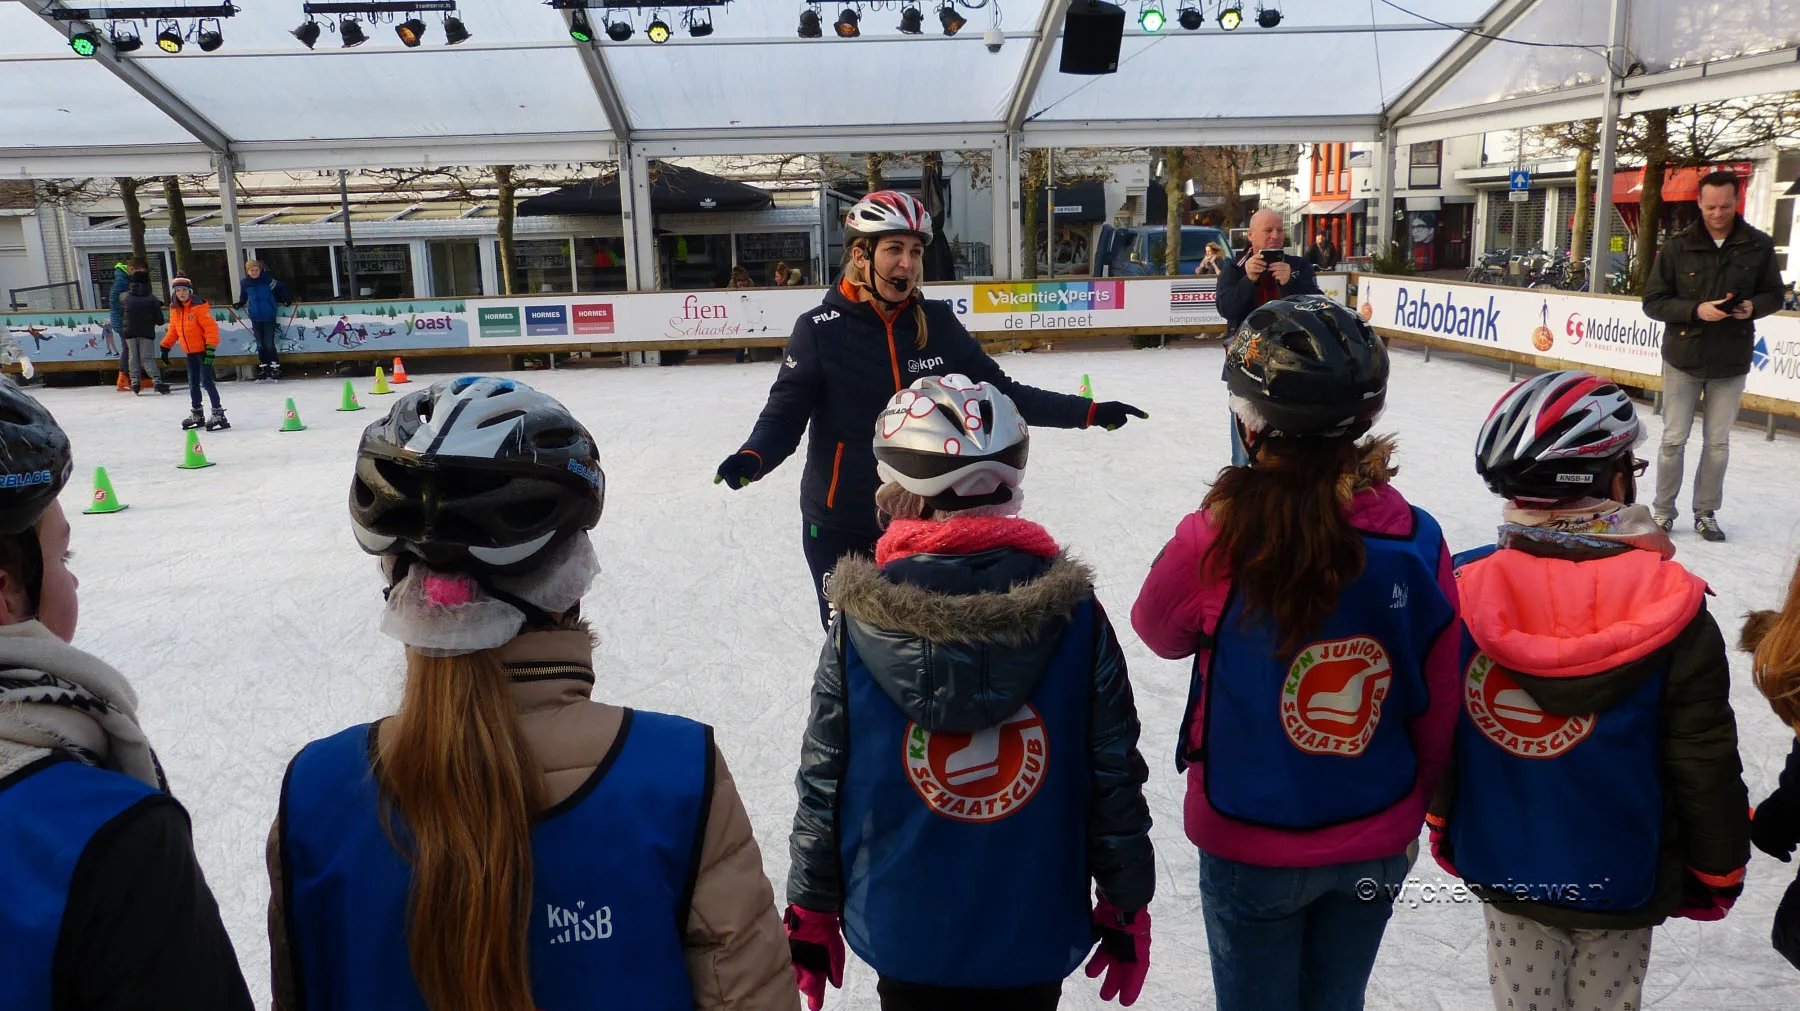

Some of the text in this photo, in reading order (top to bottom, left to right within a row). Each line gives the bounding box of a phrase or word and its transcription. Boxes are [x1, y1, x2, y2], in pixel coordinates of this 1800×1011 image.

[682, 295, 728, 320] fien
[987, 287, 1110, 306] VakantieXperts
[531, 311, 561, 319] HORMES
[811, 310, 841, 324] FILA
[1004, 313, 1093, 329] de Planeet
[1394, 287, 1501, 342] Rabobank
[1585, 317, 1661, 349] Modderkolk
[919, 356, 944, 371] kpn
[1559, 474, 1591, 482] KNSB-M
[1285, 650, 1315, 696] KPN
[1470, 654, 1487, 684] KP
[1283, 686, 1385, 753] SCHAATSCLUB
[912, 738, 1043, 816] SCHAATSCLUB
